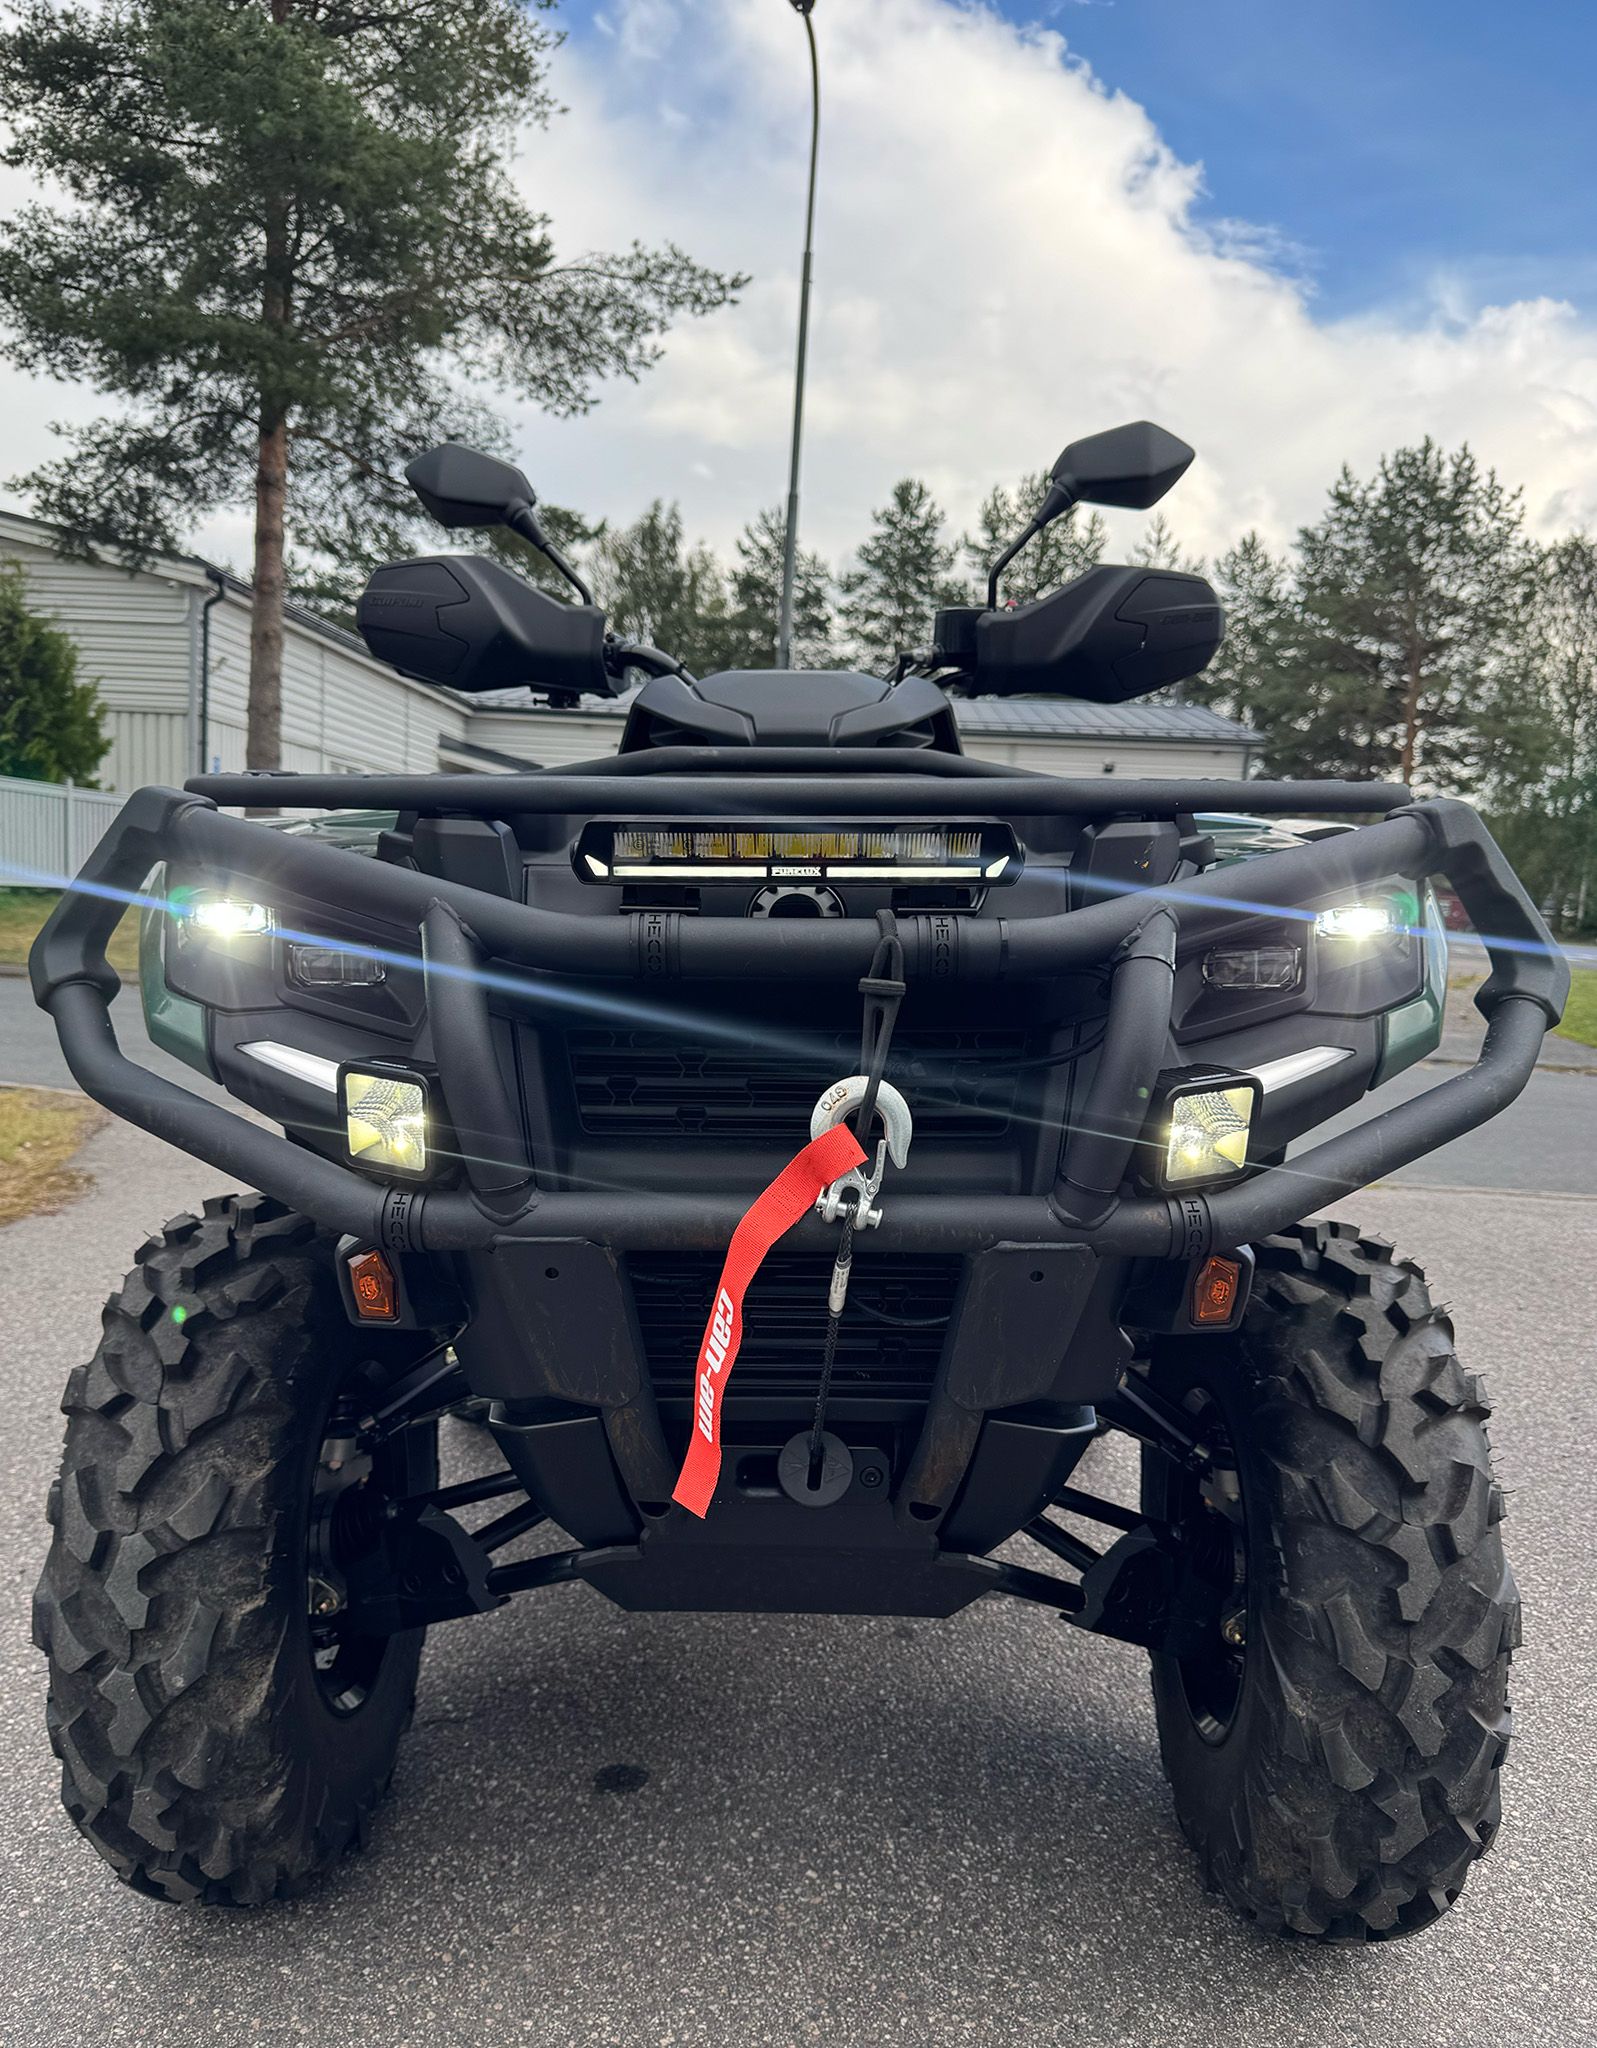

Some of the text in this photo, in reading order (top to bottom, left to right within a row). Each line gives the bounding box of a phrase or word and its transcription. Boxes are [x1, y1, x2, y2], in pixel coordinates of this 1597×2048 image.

[771, 866, 822, 877] PURELUX
[646, 913, 662, 972] HECO
[935, 917, 950, 974] HECO
[391, 1192, 409, 1250] HECO
[1185, 1200, 1203, 1256] HECO
[698, 1287, 735, 1443] can-am
